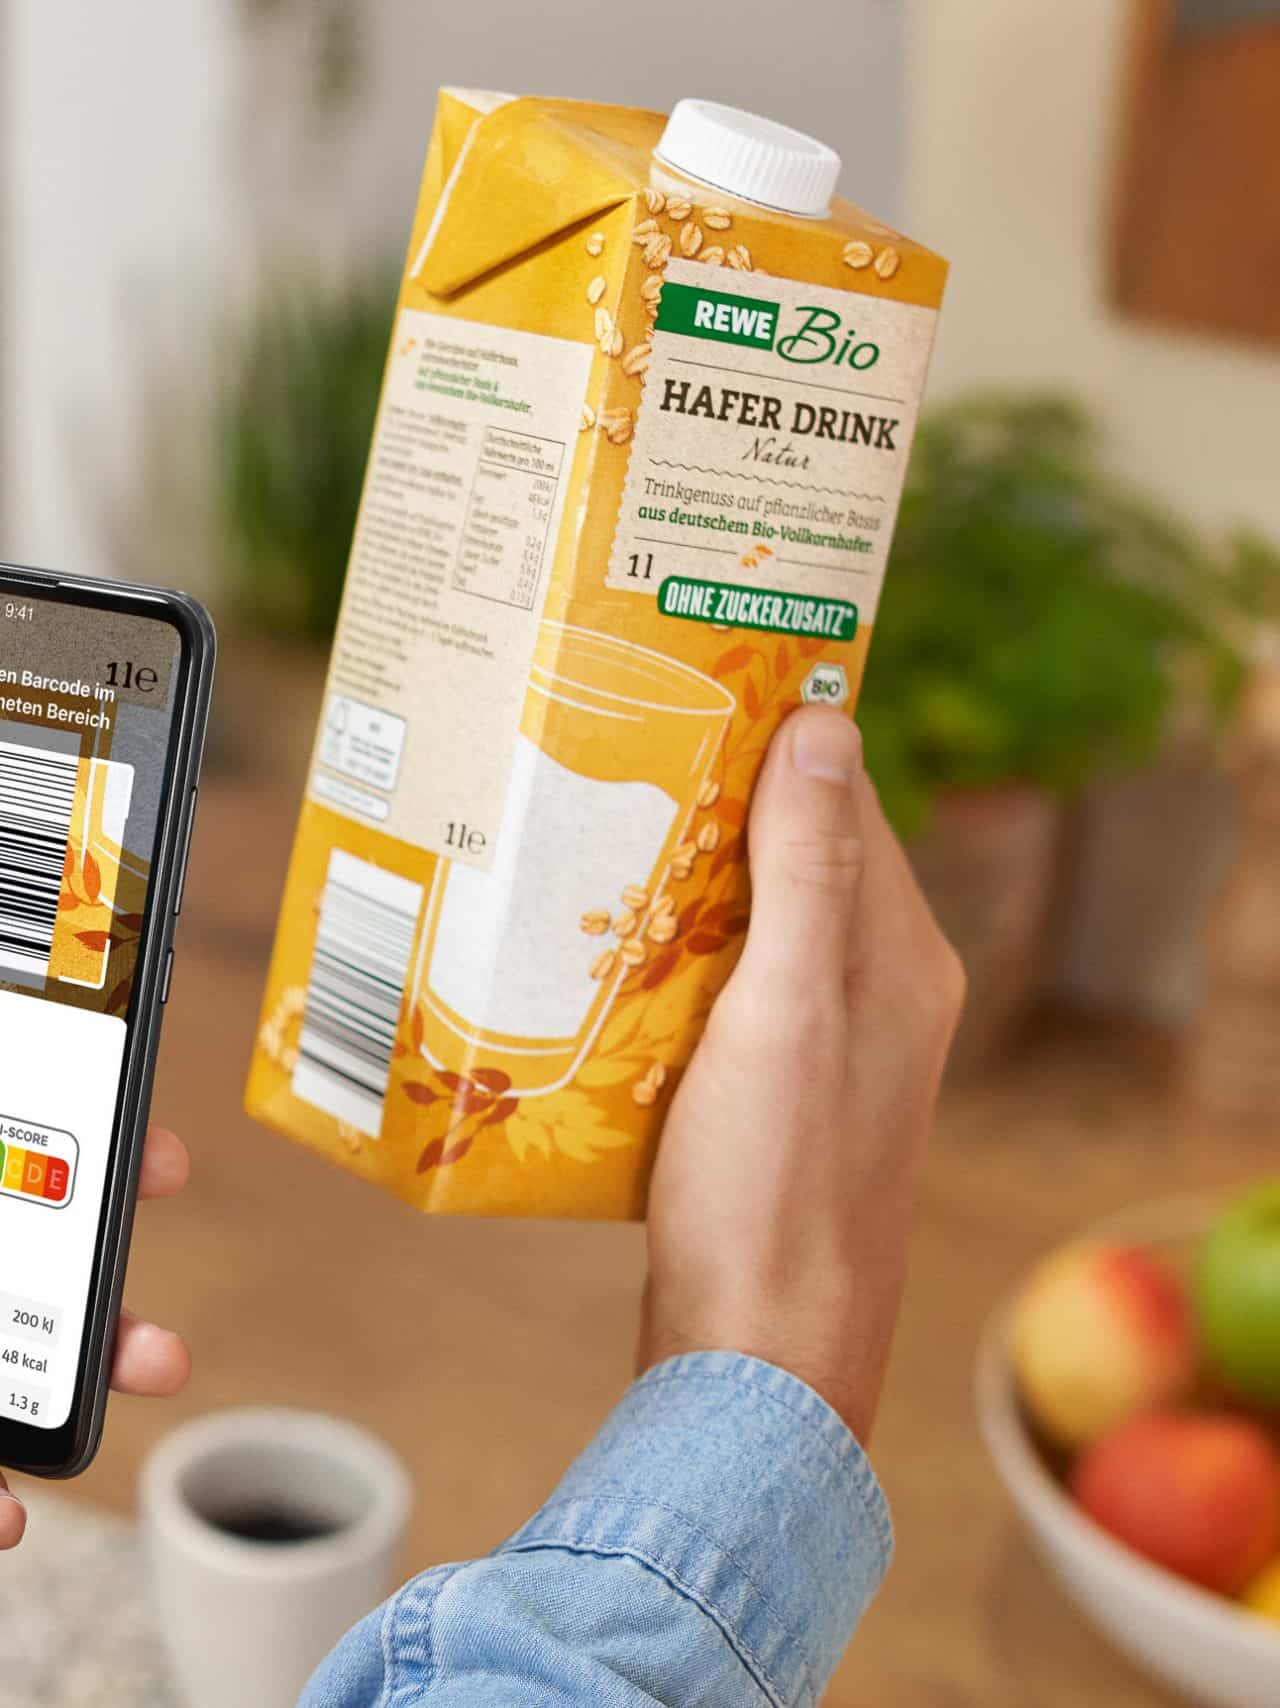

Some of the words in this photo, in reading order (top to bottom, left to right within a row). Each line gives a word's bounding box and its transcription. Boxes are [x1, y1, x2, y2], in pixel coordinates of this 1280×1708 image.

[694, 300, 773, 340] REWE
[776, 306, 880, 370] Bio
[660, 379, 782, 430] HAFER
[791, 402, 899, 450] DRINK
[742, 437, 810, 471] Natur
[644, 478, 734, 508] Trinkgenuss
[737, 495, 764, 511] auf
[763, 498, 844, 525] pflanzlicher
[847, 510, 880, 531] Basis
[638, 505, 666, 522] aus
[669, 506, 749, 535] deutschem
[5, 603, 34, 621] 9:41
[664, 581, 716, 618] OHNE
[22, 671, 90, 698] Barcode
[94, 684, 115, 702] im
[47, 703, 111, 729] Bereich
[12, 1309, 39, 1328] 200
[42, 1316, 54, 1334] kJ
[1, 1349, 19, 1364] 48
[22, 1353, 47, 1373] kcal
[9, 1393, 28, 1410] 1.3
[30, 1401, 39, 1416] g
